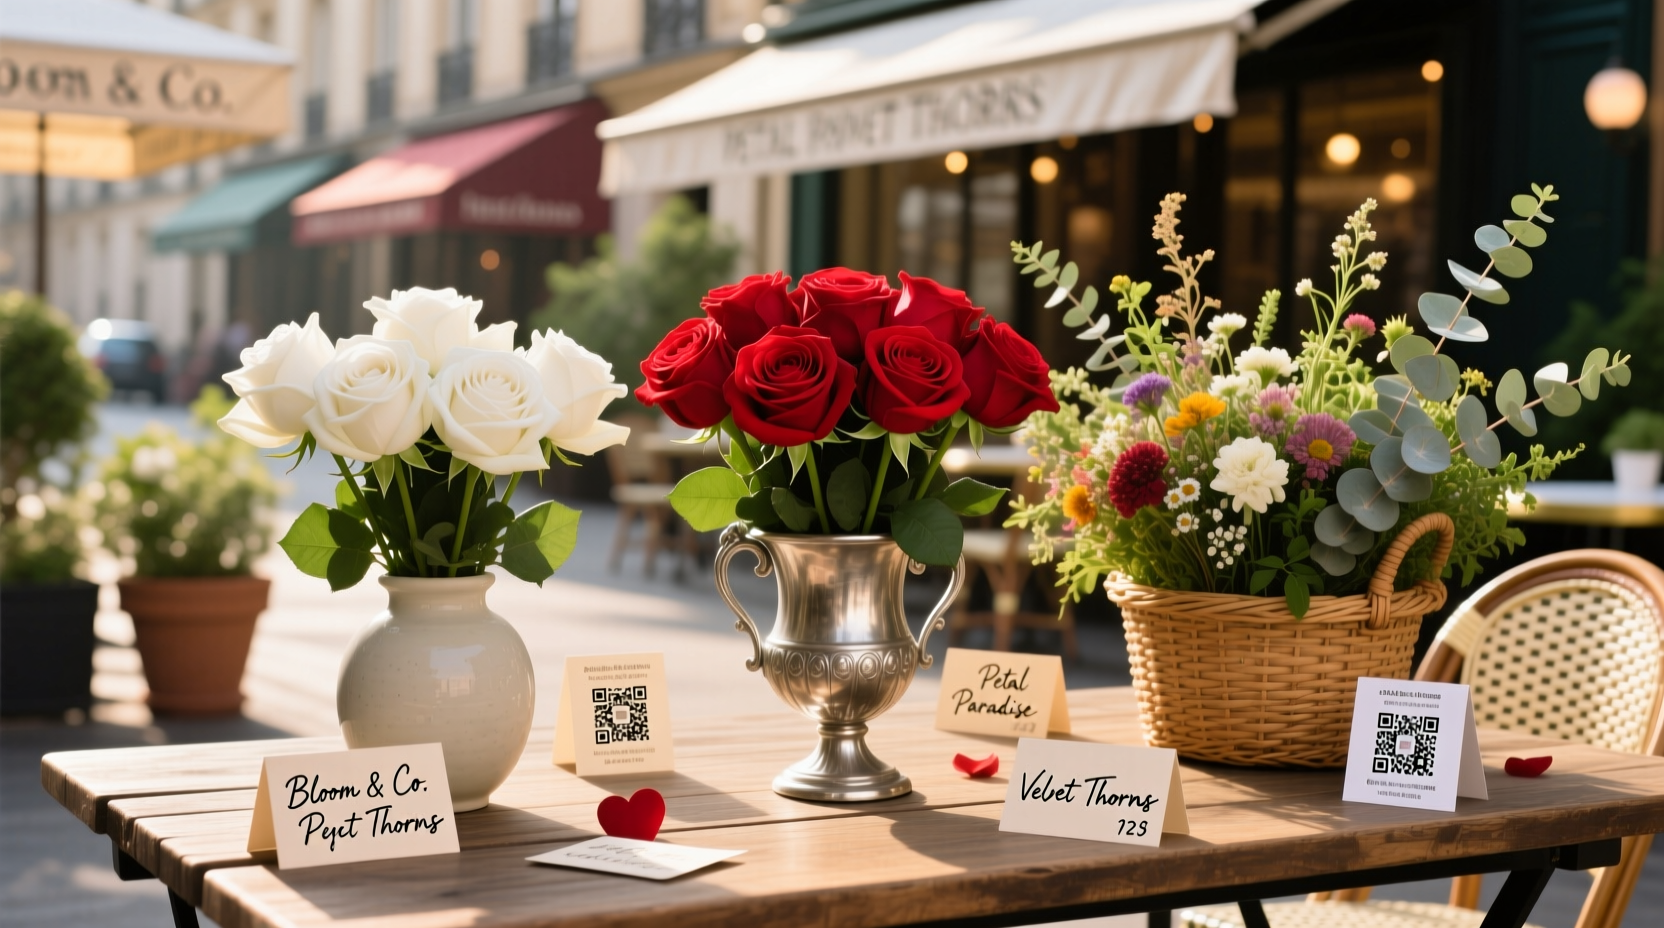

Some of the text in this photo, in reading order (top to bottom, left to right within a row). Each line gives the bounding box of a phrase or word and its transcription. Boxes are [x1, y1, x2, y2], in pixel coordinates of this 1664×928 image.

[107, 58, 142, 108] &
[158, 61, 234, 114] Co.
[978, 663, 1030, 691] Petal
[951, 688, 1038, 719] Paradise
[285, 763, 427, 809] Bloom & Co.
[1084, 775, 1159, 812] Thorns
